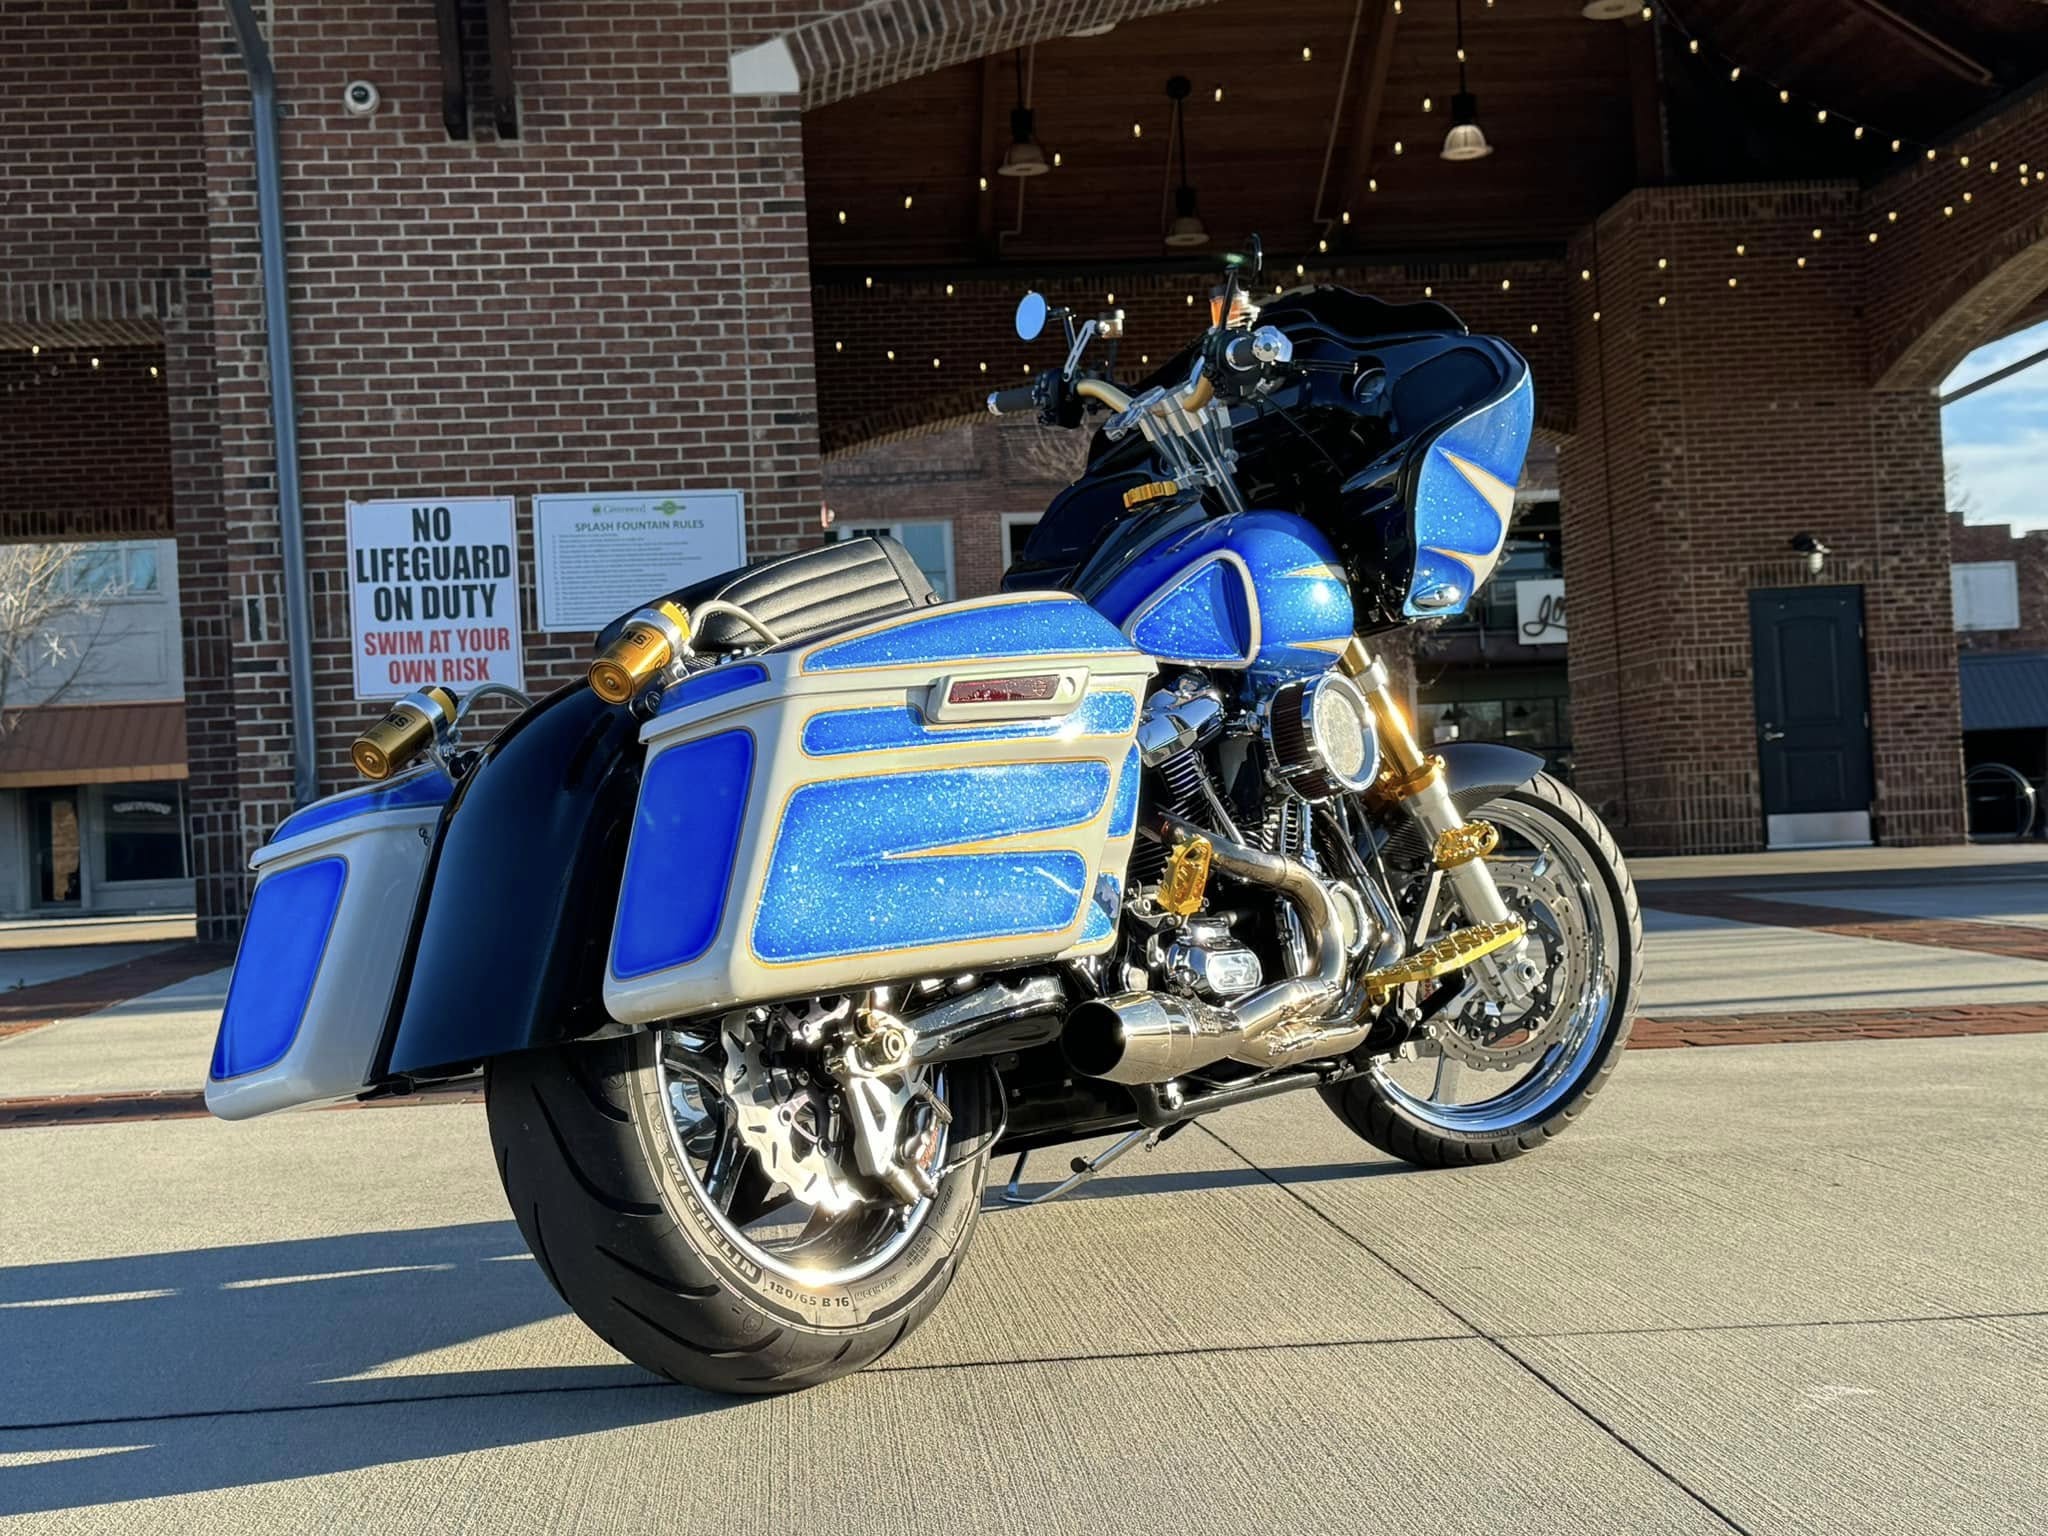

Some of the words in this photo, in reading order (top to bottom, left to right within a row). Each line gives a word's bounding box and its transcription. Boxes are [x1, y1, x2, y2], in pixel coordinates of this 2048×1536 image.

[412, 507, 451, 542] NO
[575, 522, 614, 532] SPLASH
[616, 520, 670, 531] FOUNTAIN
[672, 519, 705, 529] RULES
[355, 544, 511, 584] LIFEGUARD
[374, 586, 413, 622] ON
[422, 583, 497, 620] DUTY
[364, 631, 424, 656] SWIM
[429, 629, 452, 653] AT
[456, 627, 510, 651] YOUR
[388, 659, 436, 684] OWN
[442, 657, 490, 681] RISK
[667, 1157, 758, 1279] MICHELIN
[768, 1281, 818, 1306] 180/65
[821, 1297, 832, 1308] B
[834, 1296, 850, 1308] 16
